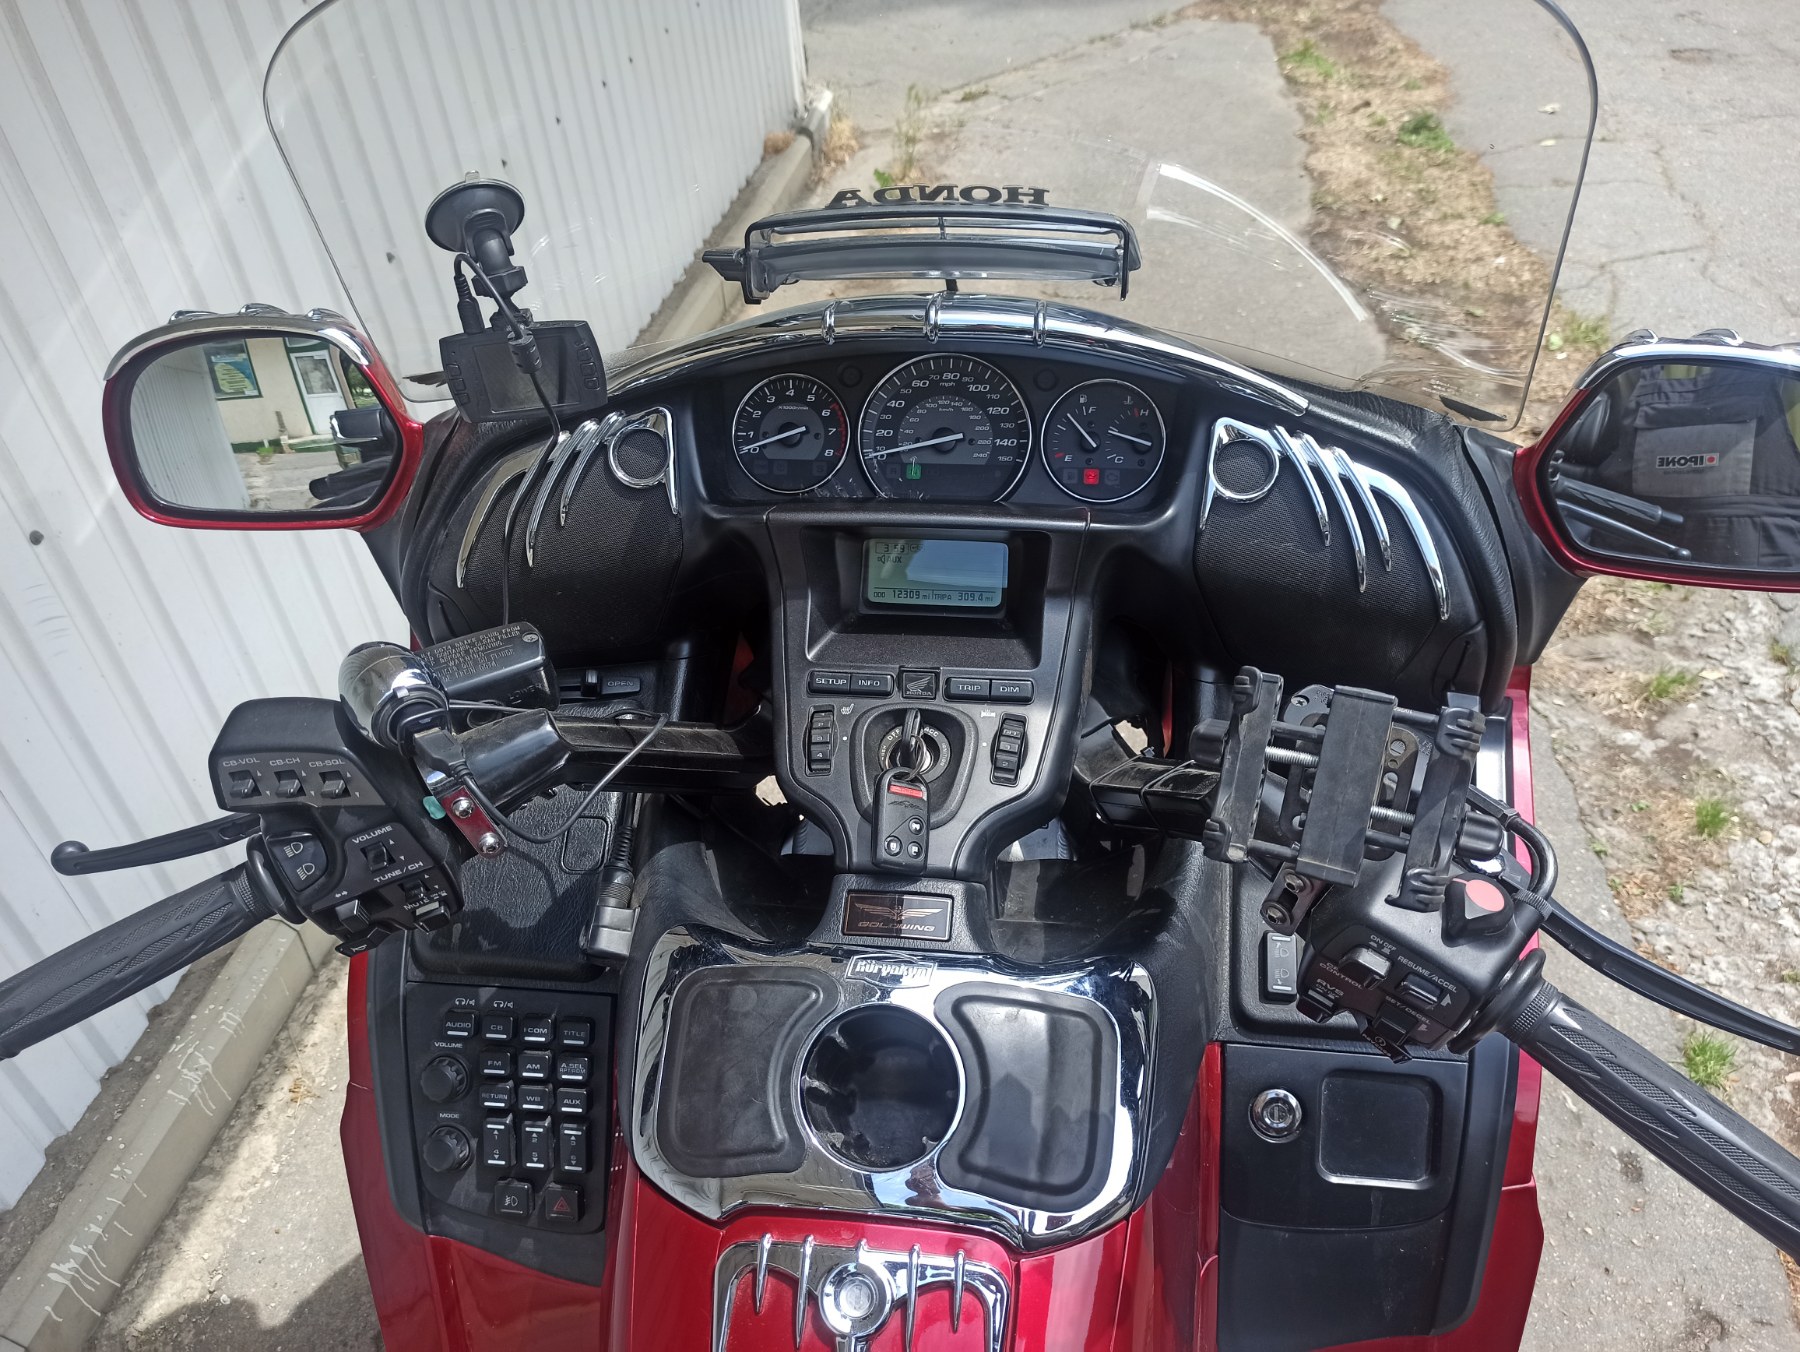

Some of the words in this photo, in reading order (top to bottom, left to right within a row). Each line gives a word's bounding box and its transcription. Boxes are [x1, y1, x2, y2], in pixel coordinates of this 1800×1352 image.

[893, 590, 920, 599] 12309
[958, 592, 983, 602] 309.4
[502, 625, 521, 633] FROM
[448, 652, 485, 667] WARNING
[607, 680, 634, 688] OPEN
[815, 677, 847, 686] SETUP
[858, 679, 880, 687] INFO
[956, 684, 981, 692] TRIP
[1000, 685, 1020, 693] DIM
[924, 726, 939, 737] ACC
[222, 757, 261, 767] CB-VOL
[270, 757, 300, 766] CB-CH
[309, 759, 346, 767] CB-SQL
[352, 825, 393, 844] VOLUME
[1370, 935, 1383, 944] ON
[1384, 942, 1396, 951] OFF
[1320, 963, 1363, 989] CONTROL
[1398, 955, 1457, 993] RESUME/ACCEL
[1385, 995, 1431, 1025] SET/DECEL
